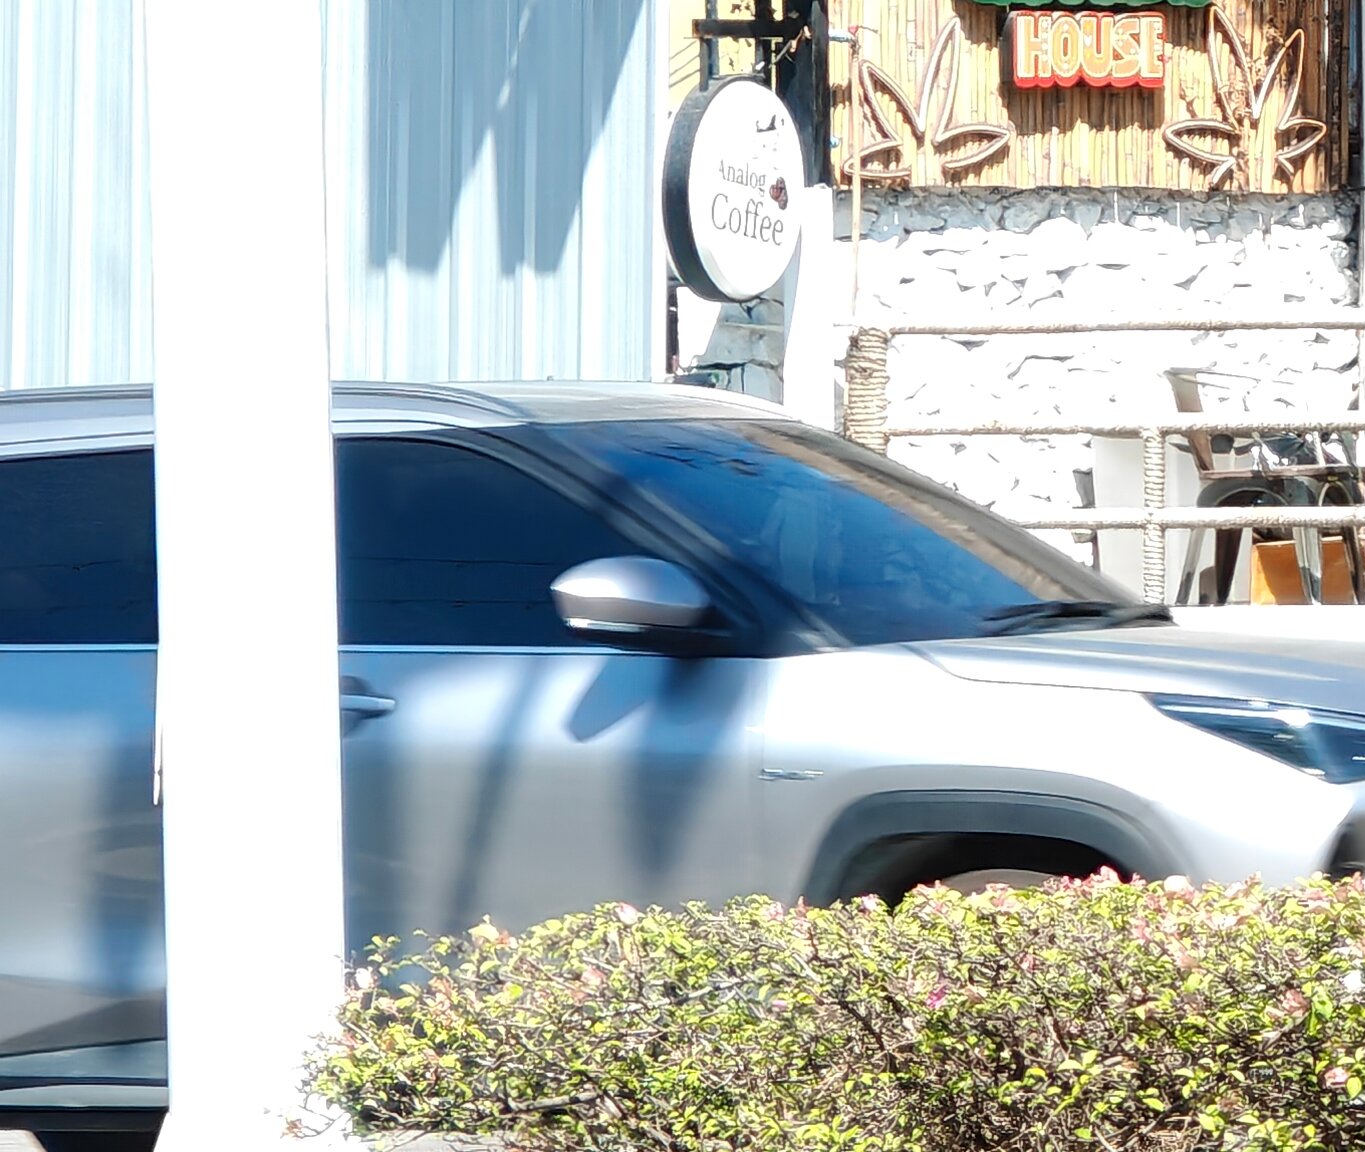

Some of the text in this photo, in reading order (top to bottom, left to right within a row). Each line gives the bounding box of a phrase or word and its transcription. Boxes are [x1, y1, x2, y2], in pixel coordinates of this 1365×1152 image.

[1014, 13, 1165, 82] HOUSE
[718, 159, 767, 197] Analog
[711, 193, 784, 246] Coffee
